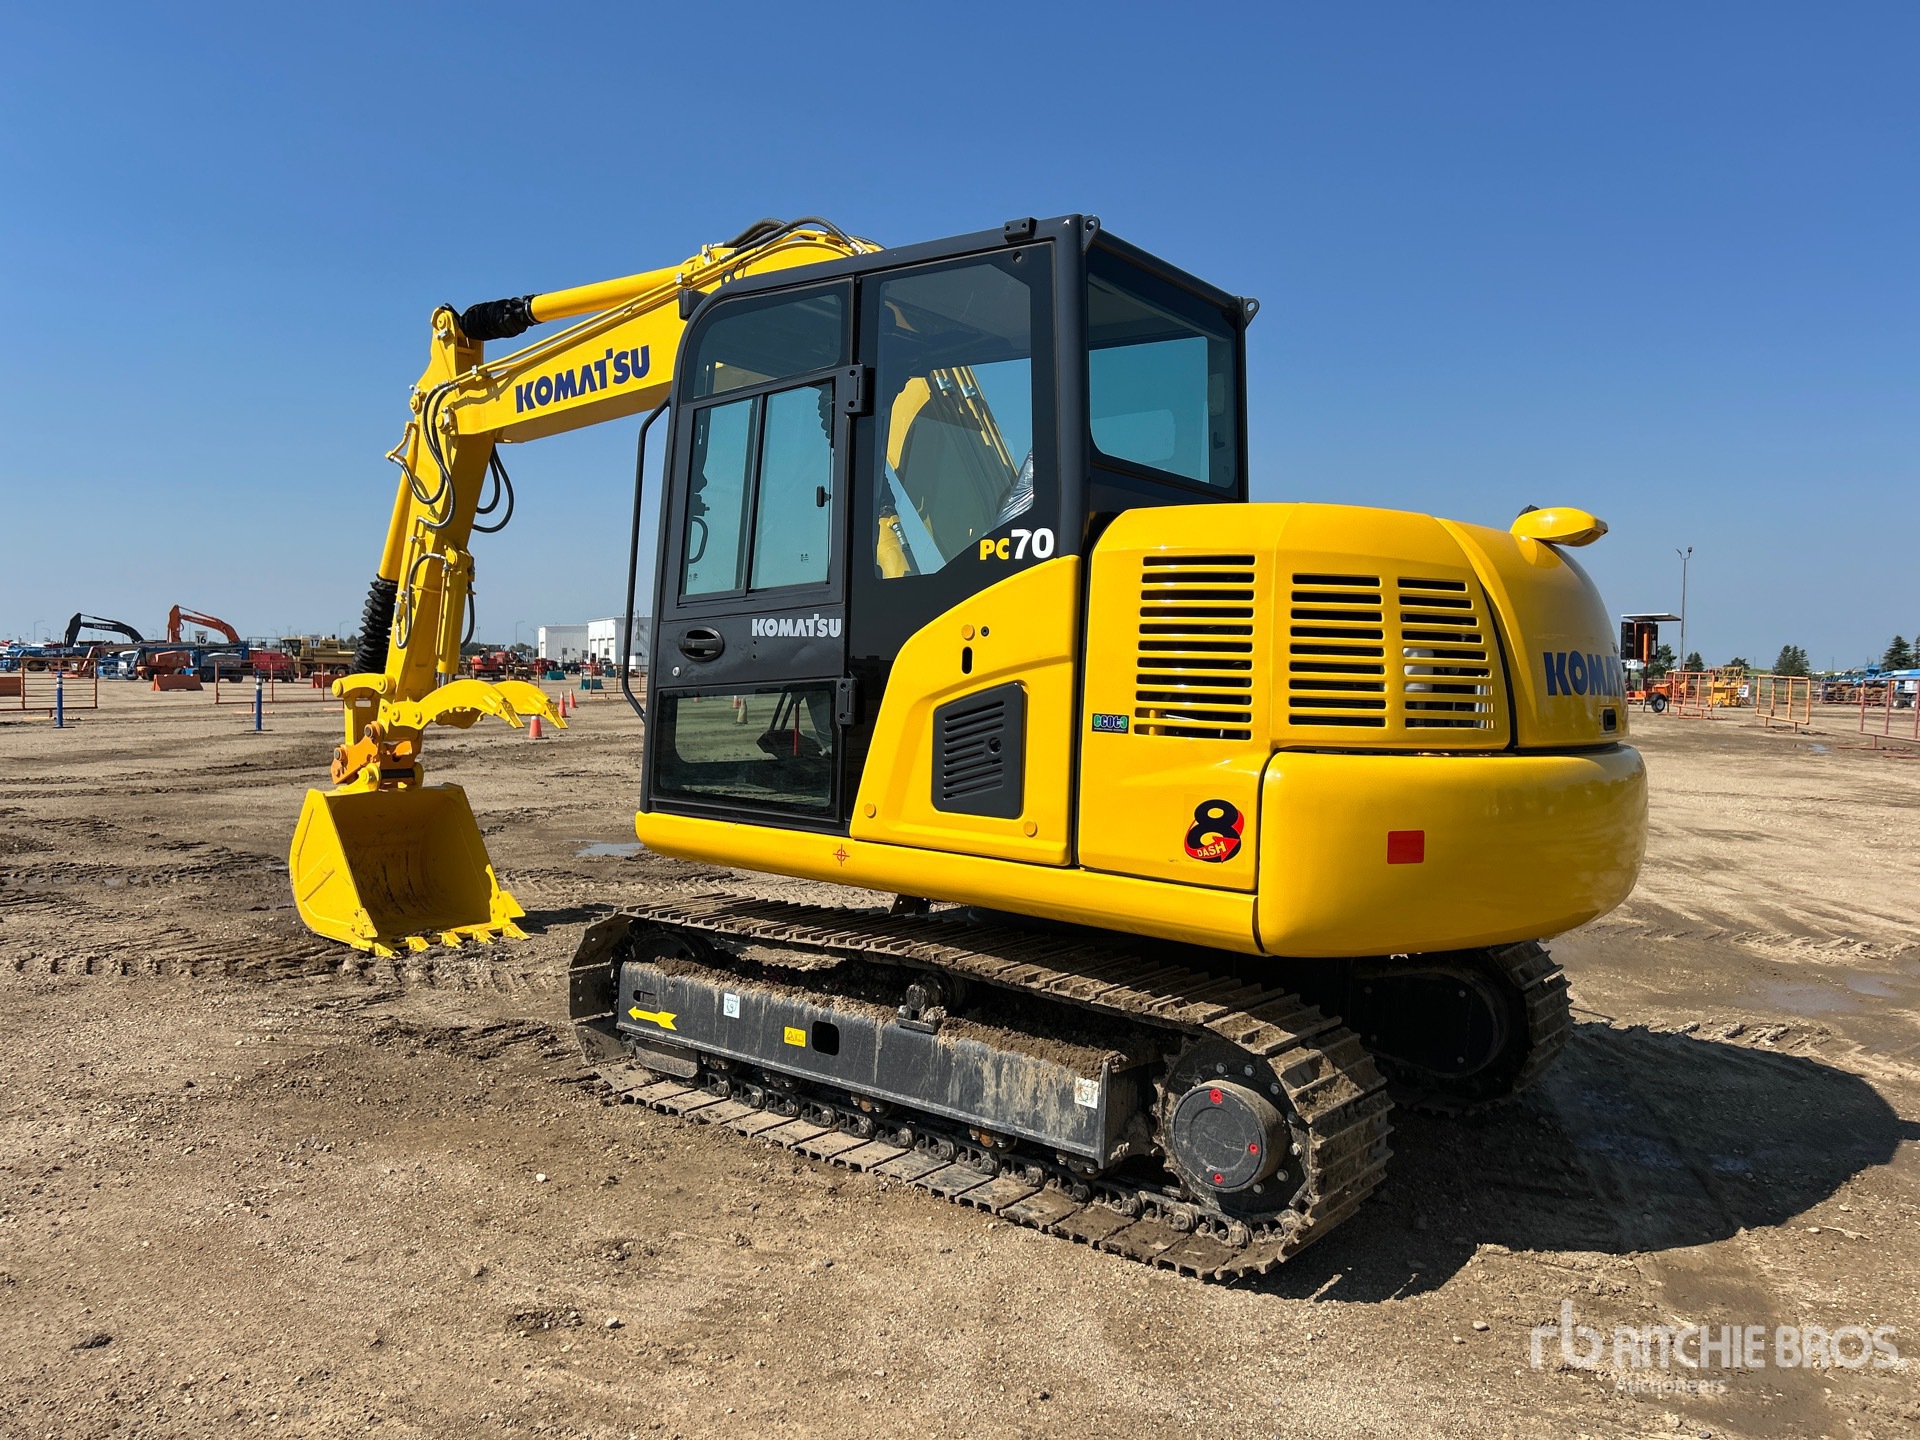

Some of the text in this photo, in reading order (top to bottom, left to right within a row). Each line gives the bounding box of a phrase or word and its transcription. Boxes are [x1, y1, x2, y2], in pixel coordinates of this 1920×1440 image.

[515, 344, 650, 414] KOMATSU
[979, 527, 1055, 561] PC70
[751, 613, 842, 638] KOMATSU
[196, 635, 207, 644] 16
[310, 638, 320, 647] 17
[1186, 798, 1242, 863] 8
[1197, 841, 1227, 857] DASH
